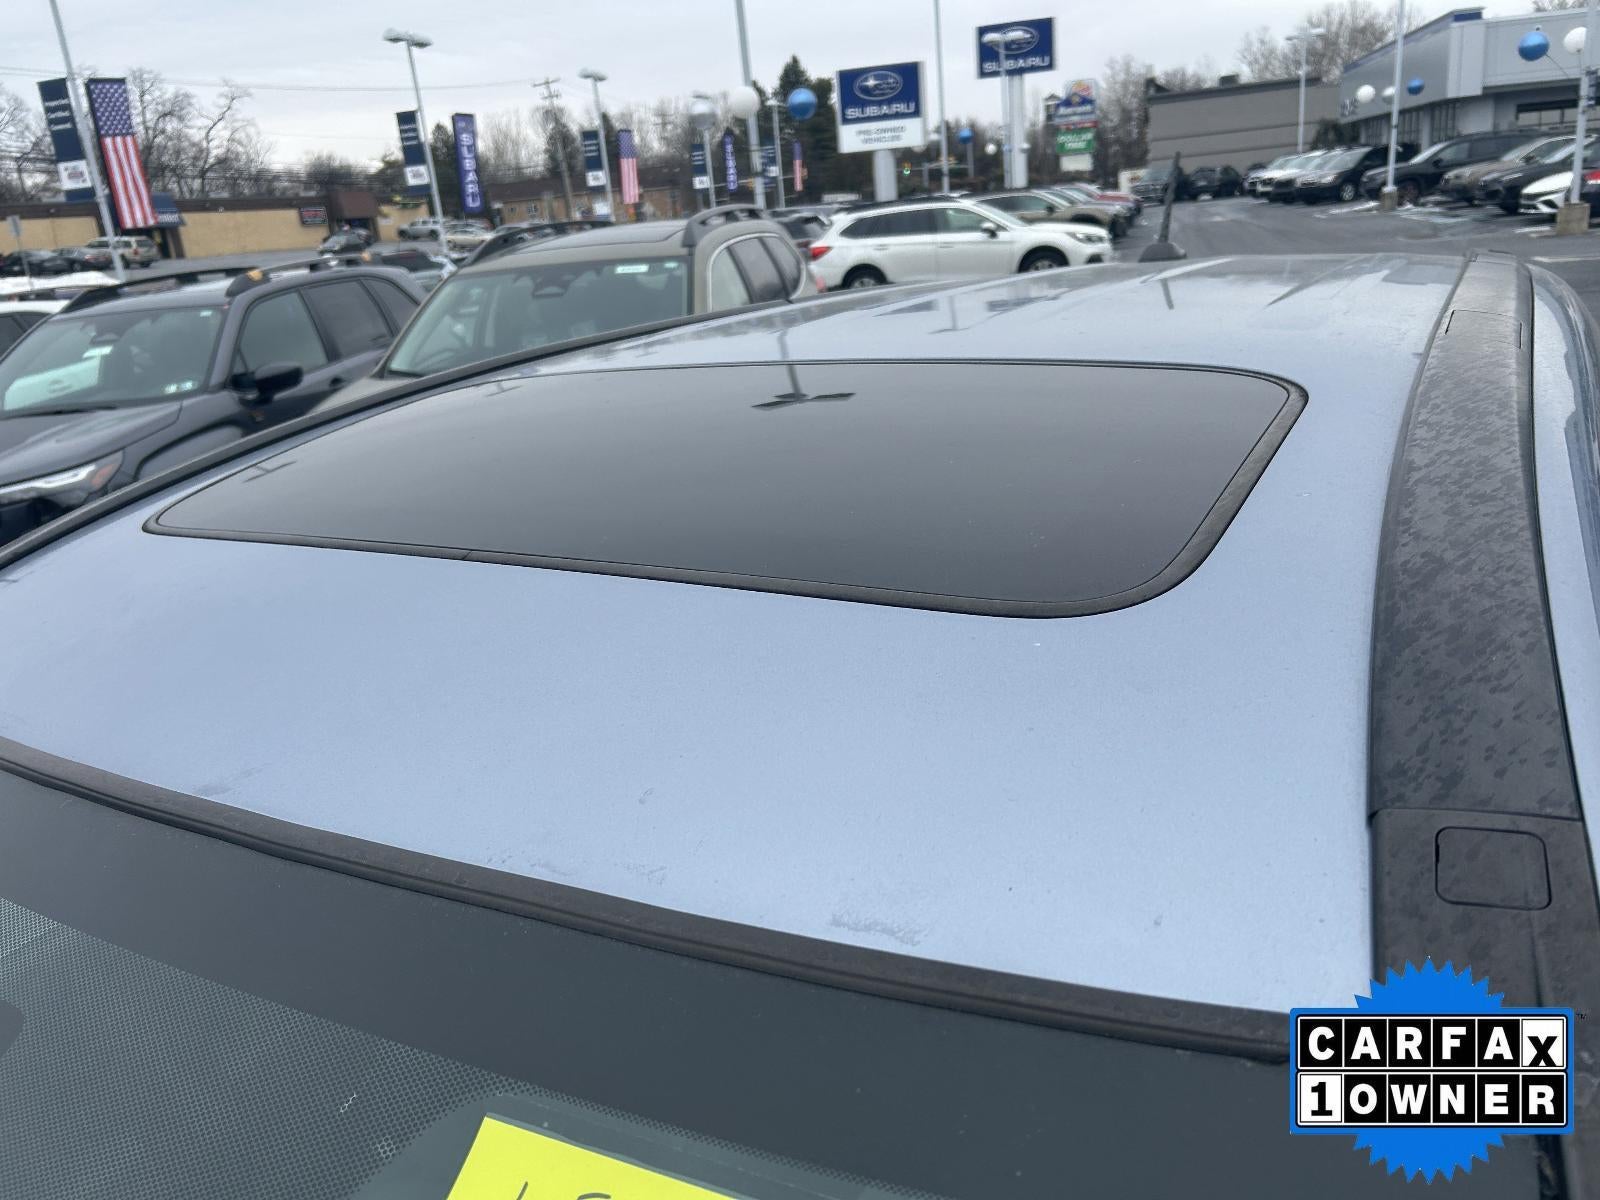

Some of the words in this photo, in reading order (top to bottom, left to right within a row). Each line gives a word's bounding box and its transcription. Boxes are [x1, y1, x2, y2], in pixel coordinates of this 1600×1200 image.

[982, 56, 1051, 73] SUBARU
[844, 102, 916, 119] SUBARU
[460, 133, 481, 208] SUBARU
